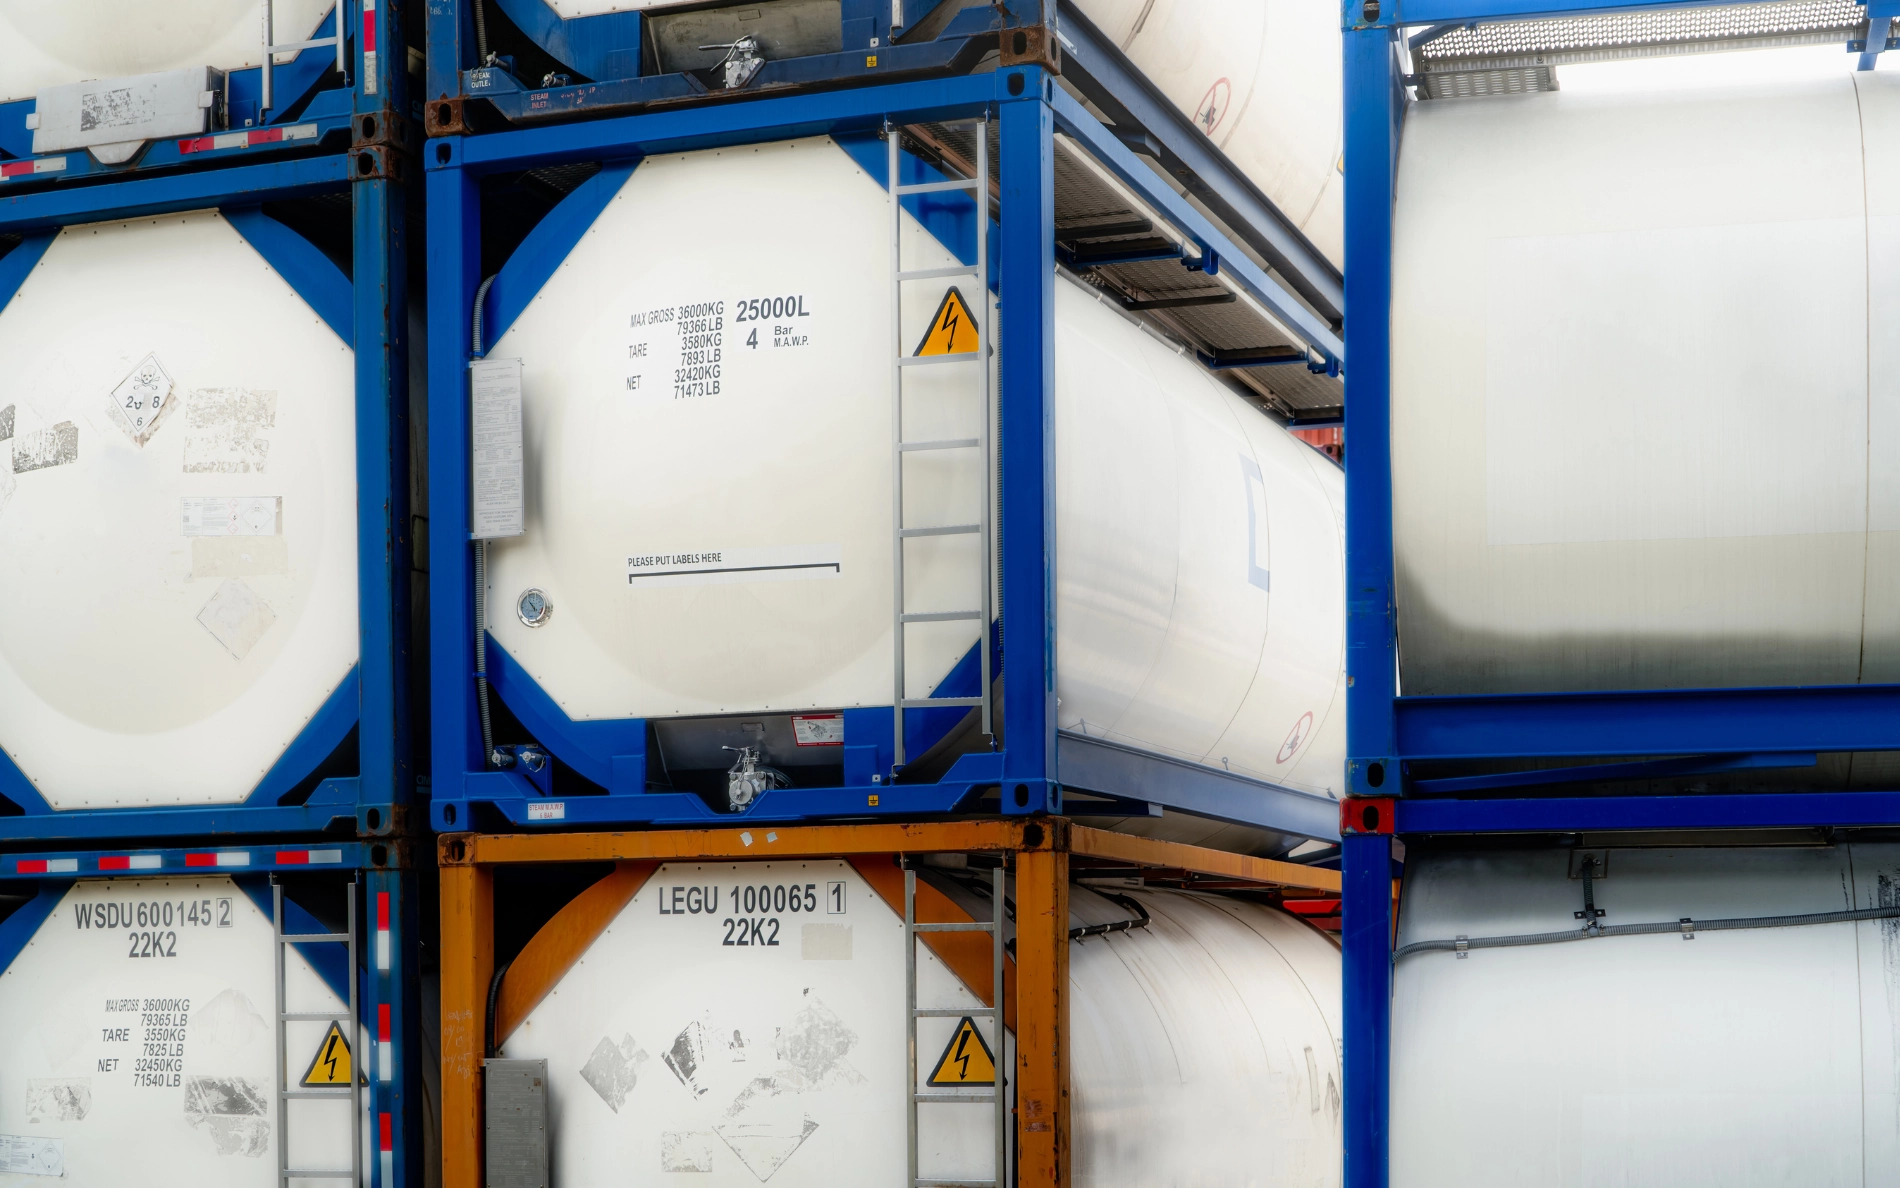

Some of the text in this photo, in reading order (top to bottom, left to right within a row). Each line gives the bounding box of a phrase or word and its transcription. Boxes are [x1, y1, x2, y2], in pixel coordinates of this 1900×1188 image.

[471, 80, 490, 88] OUTLE
[630, 301, 724, 328] MAX GROSS 36000KG
[736, 295, 810, 322] 25000L
[677, 317, 723, 335] 79366 LB
[774, 325, 793, 335] Bar
[629, 333, 722, 359] TARE 3580KG
[746, 327, 758, 349] 4
[773, 336, 809, 348] M.A.W.P.
[681, 349, 721, 366] 7893 LB
[626, 365, 721, 390] NET 32420KG
[674, 380, 720, 399] 71473 LB
[136, 417, 143, 426] 6
[628, 552, 722, 567] PLEASE PUT LABELS HERE
[659, 886, 718, 915] LEGU
[730, 883, 817, 914] 100065
[218, 899, 231, 926] 2
[722, 917, 780, 946] 22K2
[128, 931, 177, 958] 22K2
[142, 998, 190, 1012] 36000KG
[141, 1013, 188, 1026] 79365 LB
[102, 1028, 186, 1042] TARE 3550KG
[143, 1043, 184, 1056] 7825 LB
[98, 1058, 183, 1072] NET 32450KG
[134, 1073, 181, 1087] 71540 LB
